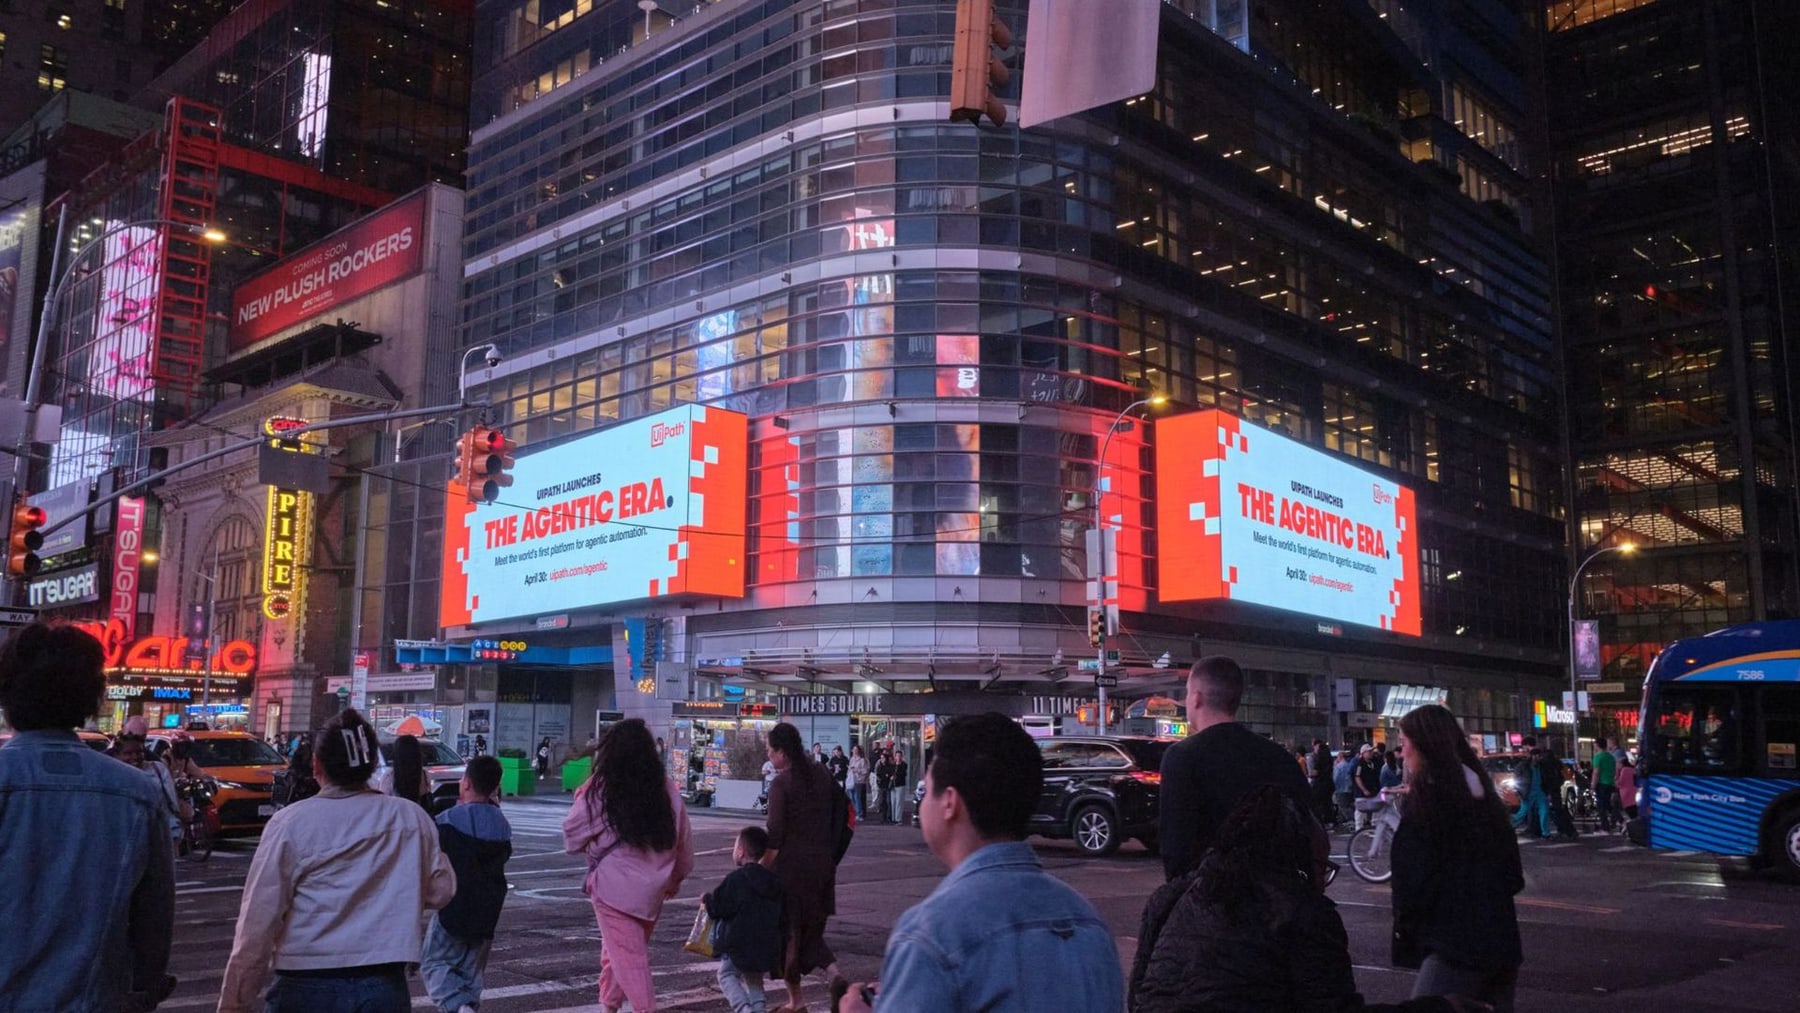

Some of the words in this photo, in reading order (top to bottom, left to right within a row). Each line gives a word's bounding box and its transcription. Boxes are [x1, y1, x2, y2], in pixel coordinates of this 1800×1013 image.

[292, 254, 323, 276] COMING
[324, 241, 349, 260] SOON
[238, 291, 273, 325] NEW
[274, 267, 325, 309] PLUSH
[328, 227, 413, 284] ROCKERS
[651, 422, 685, 448] UiPath
[536, 483, 562, 500] UIPATH
[562, 473, 602, 494] LAUNCHES
[1291, 480, 1314, 499] UIPATH
[1313, 488, 1344, 509] LAUNCHES
[484, 514, 518, 550] THE
[520, 490, 614, 543] AGENTIC
[618, 477, 674, 520] ERA.
[1237, 482, 1275, 526] THE
[1279, 497, 1354, 550] AGENTIC
[1356, 523, 1390, 560] ERA.
[274, 493, 297, 584] PIRE
[494, 554, 508, 567] Meet
[508, 552, 518, 564] the
[518, 548, 538, 563] world's
[538, 545, 550, 557] first
[550, 541, 575, 558] platform
[575, 539, 585, 550] for
[585, 535, 609, 551] agentic
[609, 526, 648, 543] automation.
[1253, 530, 1267, 546] Meet
[1268, 535, 1278, 548] the
[1278, 538, 1297, 553] world's
[1297, 542, 1307, 555] first
[1307, 547, 1329, 563] platform
[1335, 554, 1352, 568] agentic
[524, 572, 538, 586] April
[538, 571, 548, 583] 30:
[550, 560, 609, 582] uipath.com/agentic
[1286, 566, 1299, 581] April
[29, 570, 96, 606] IT'SUGAR
[9, 611, 30, 622] WAY
[1736, 670, 1765, 681] 7586
[108, 687, 144, 697] DOLBY
[153, 689, 191, 700] IMAX
[777, 696, 786, 713] 11
[789, 695, 825, 713] TIMES
[829, 694, 883, 713] SQUARE
[1033, 696, 1044, 714] 11
[1547, 705, 1575, 724] Microso
[1711, 793, 1728, 803] City
